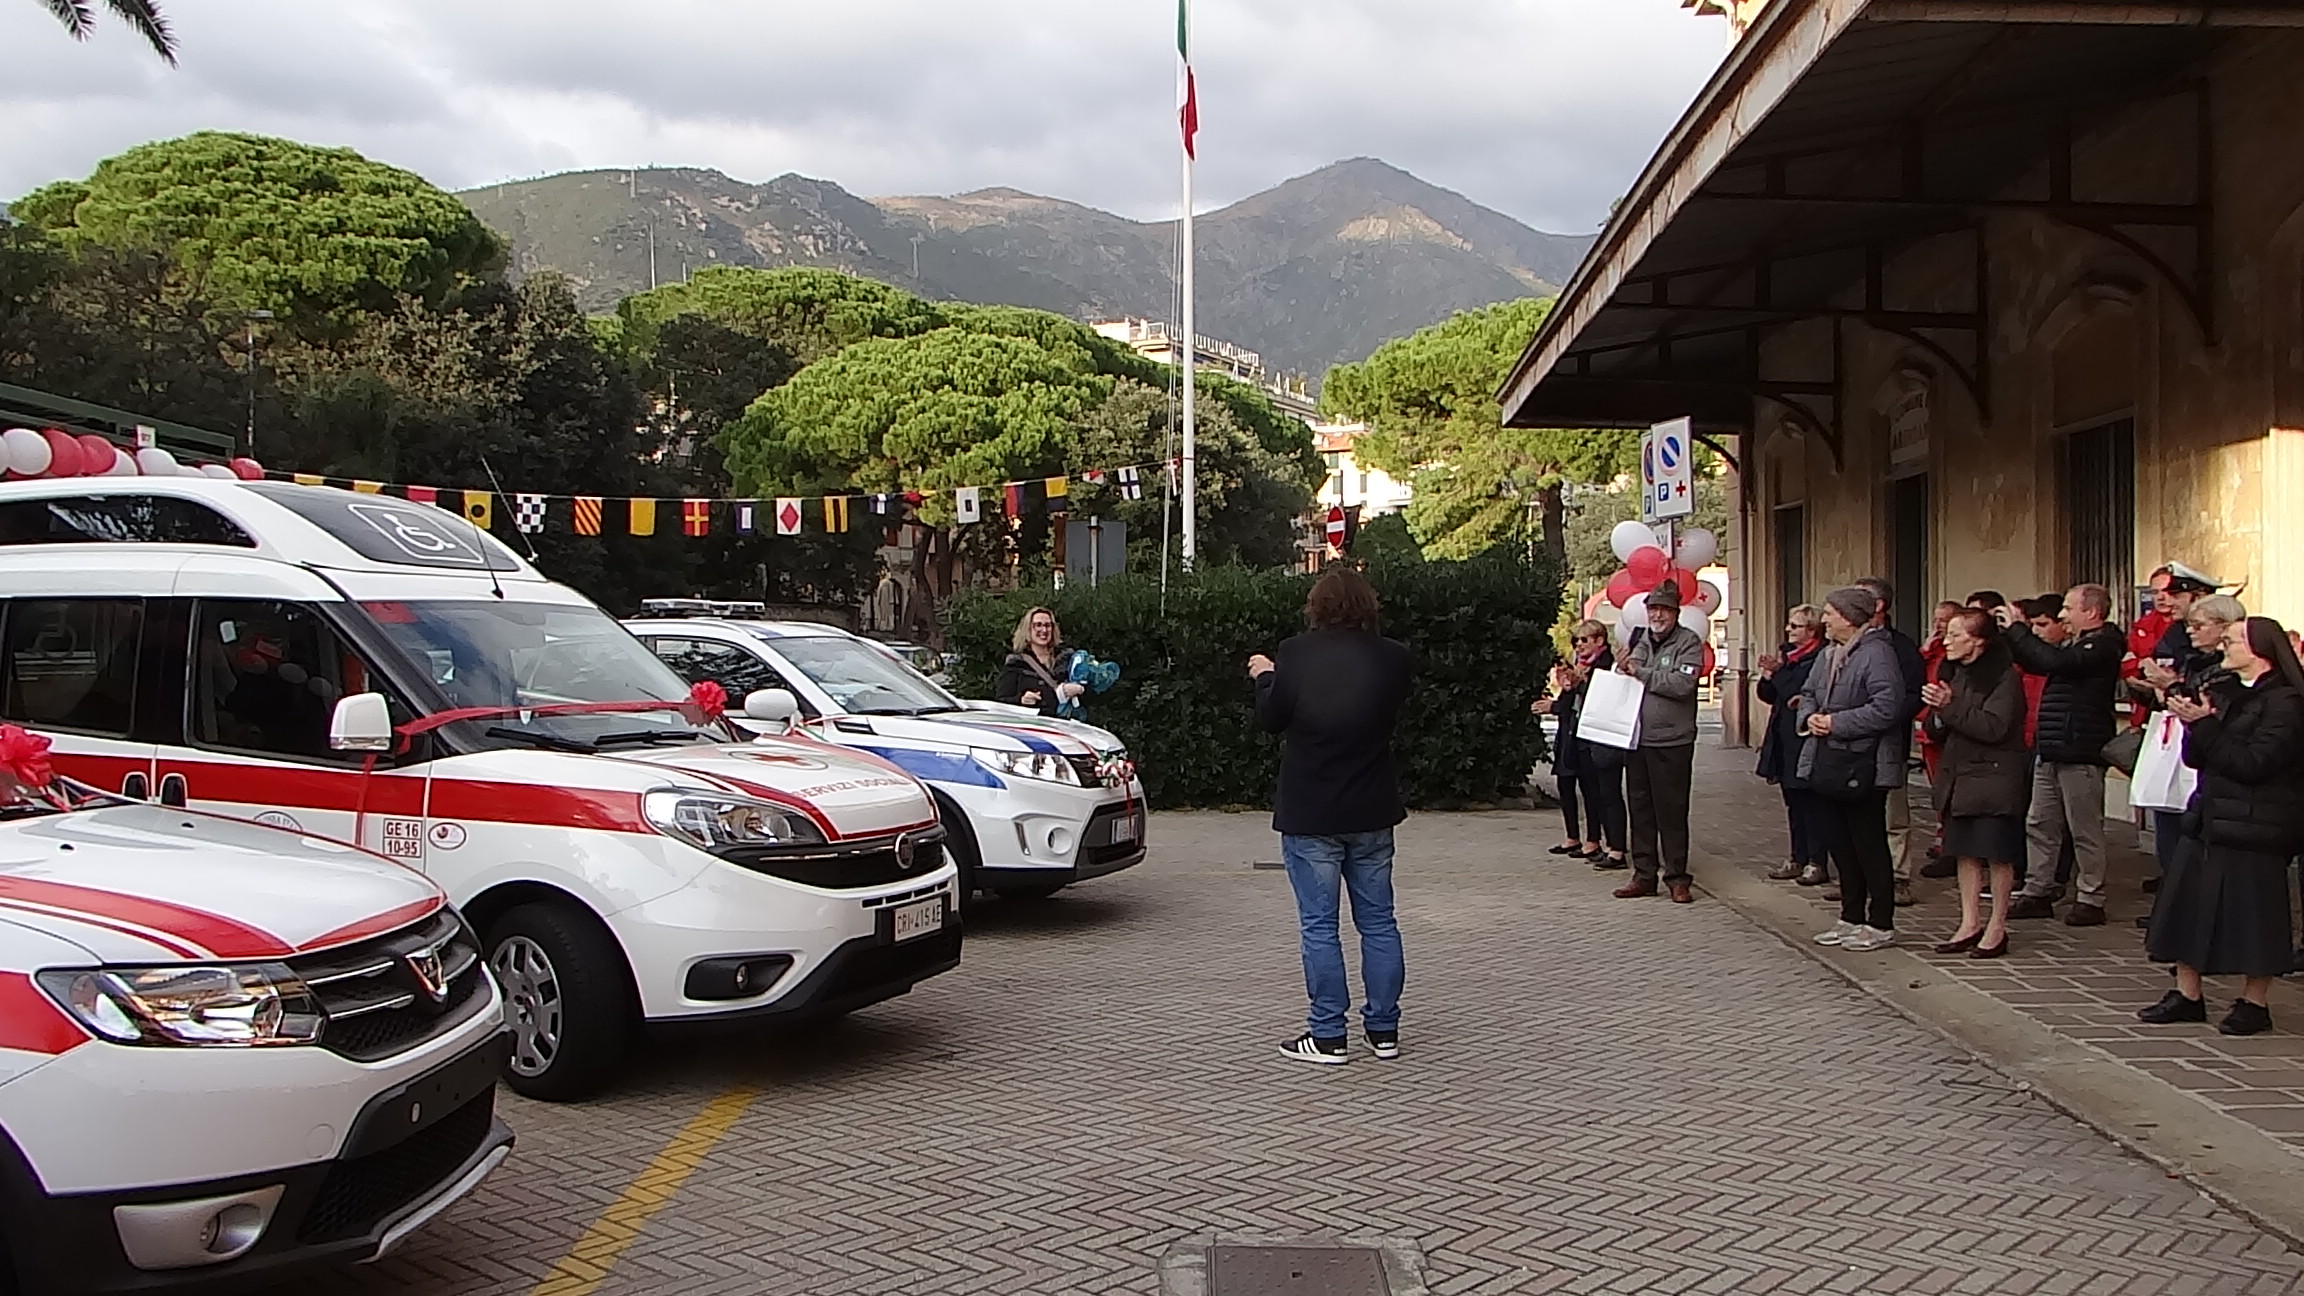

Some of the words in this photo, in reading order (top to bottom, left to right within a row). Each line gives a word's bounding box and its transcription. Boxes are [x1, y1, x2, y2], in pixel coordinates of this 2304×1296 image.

[1660, 485, 1668, 500] P
[791, 781, 858, 798] SERVIZI
[386, 821, 402, 836] GE
[405, 823, 419, 838] 16
[387, 839, 418, 855] 10-95
